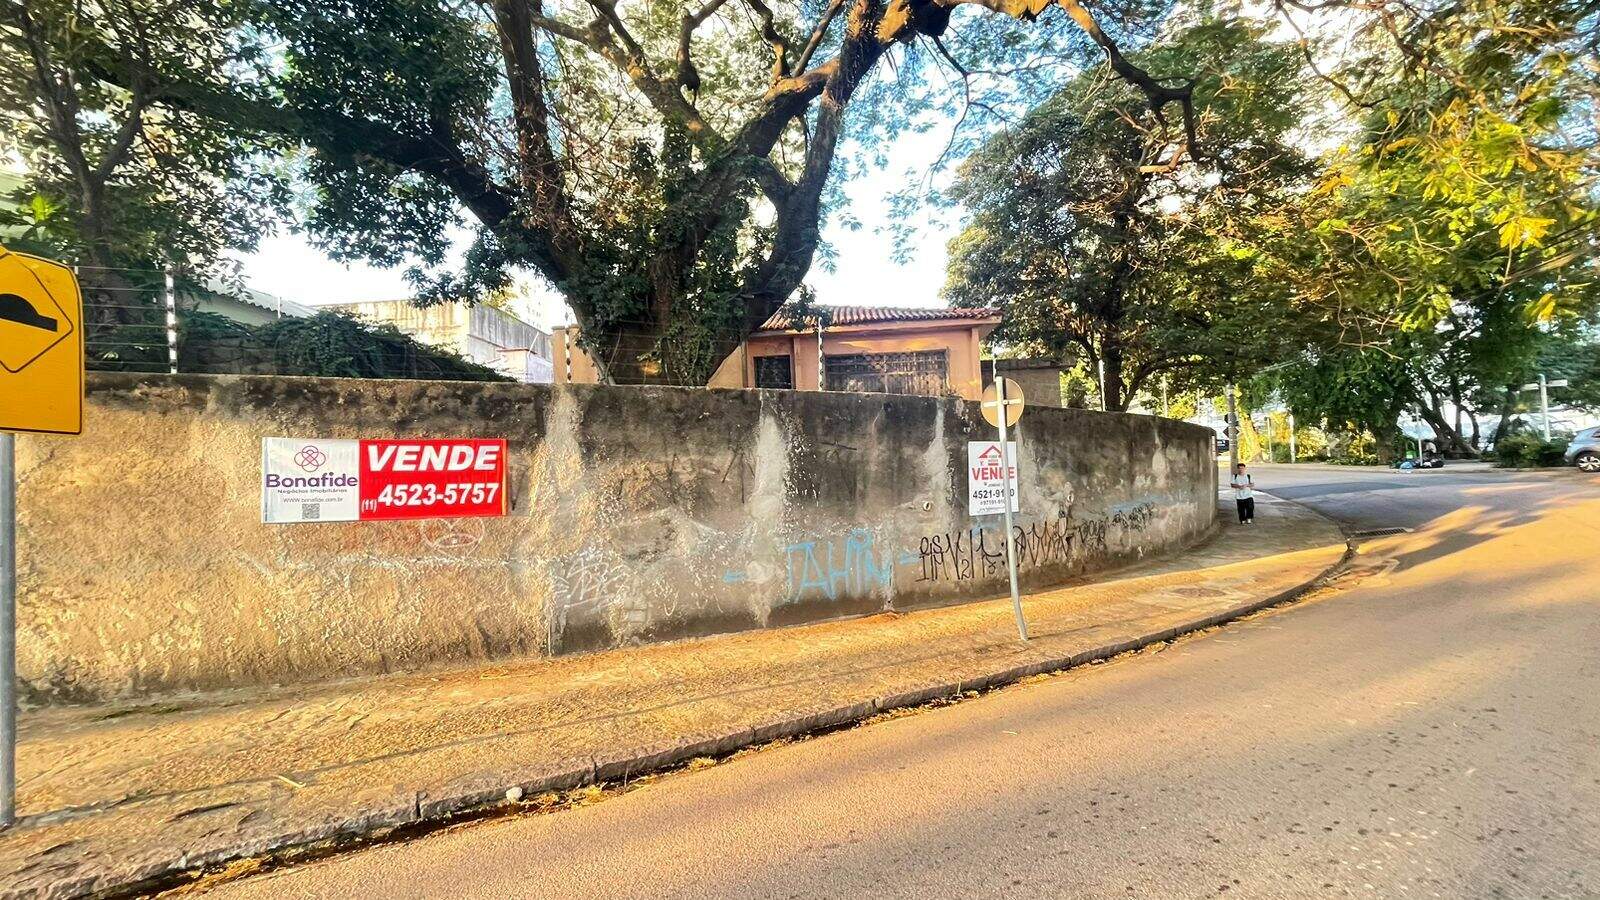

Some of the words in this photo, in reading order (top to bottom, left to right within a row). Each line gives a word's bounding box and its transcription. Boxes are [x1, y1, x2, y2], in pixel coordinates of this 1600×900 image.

[367, 444, 500, 472] VENDE
[265, 471, 358, 488] Bonafide
[361, 499, 378, 513] (11)
[377, 482, 500, 507] 4523-5757
[972, 488, 1015, 499] 4521-910
